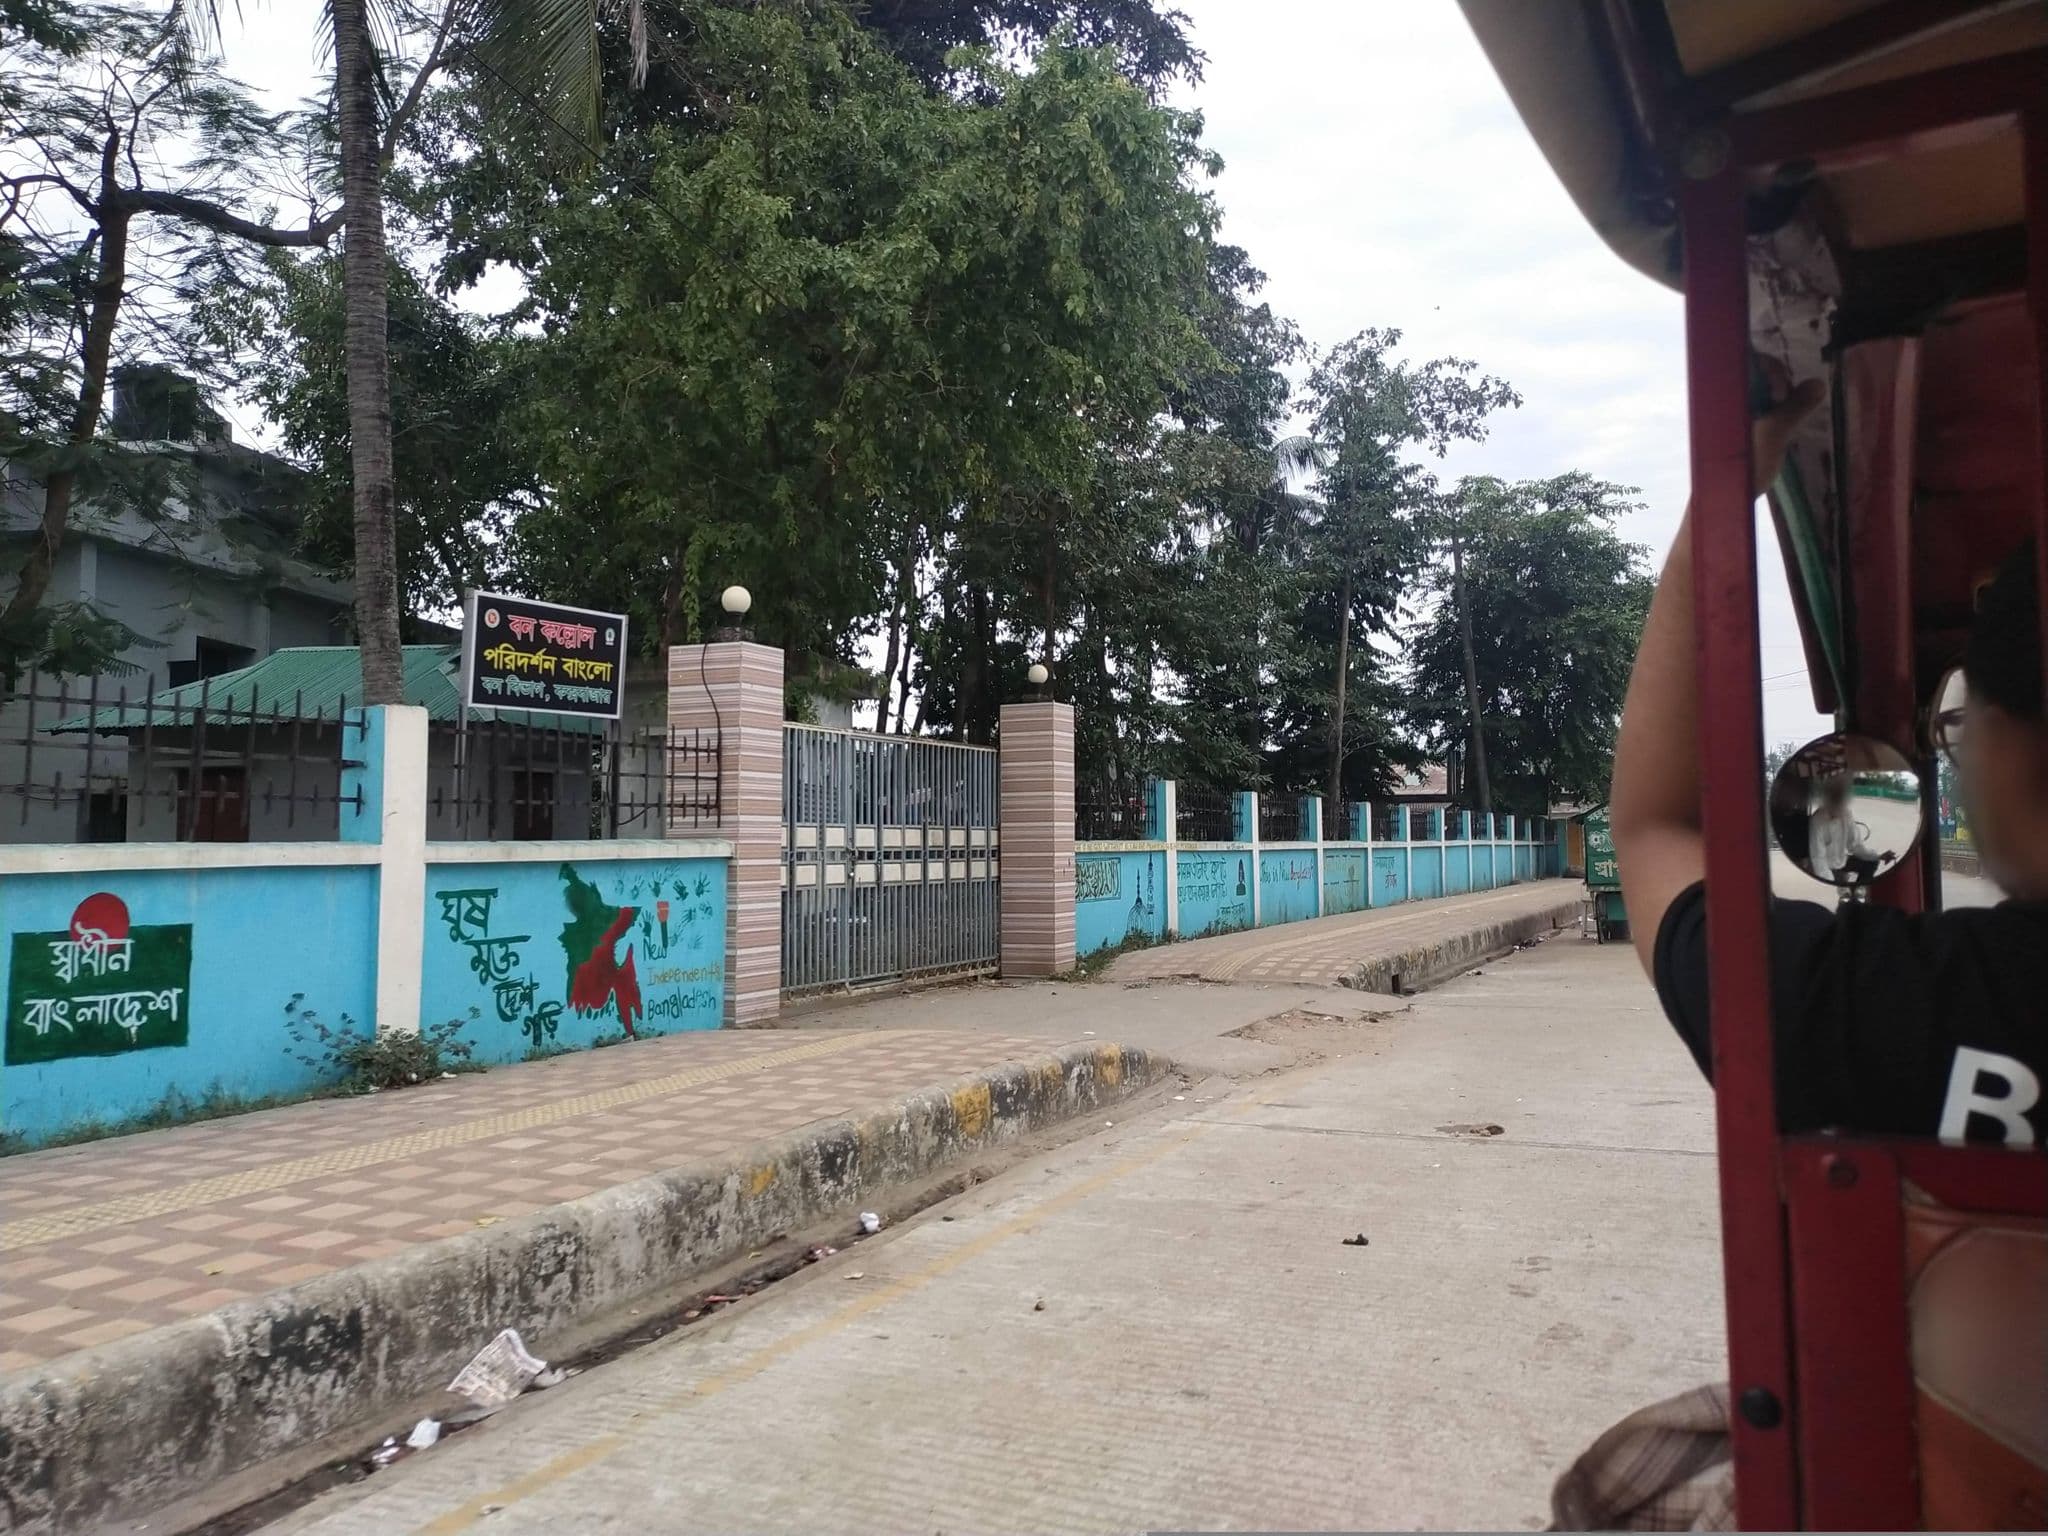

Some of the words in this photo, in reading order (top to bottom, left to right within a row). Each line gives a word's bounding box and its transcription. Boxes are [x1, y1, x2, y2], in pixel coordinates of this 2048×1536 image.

[507, 614, 537, 642] বন
[540, 618, 597, 650] কল্লোল
[484, 643, 558, 677] পরিদর্শন
[561, 657, 614, 682] বাংলো
[481, 676, 504, 695] বন
[553, 684, 613, 705] কক্সবাজার
[435, 888, 498, 942] ঘুষ
[48, 921, 135, 984] স্বাধীন
[462, 935, 532, 985] মুক্ত
[643, 937, 668, 961] New
[493, 971, 539, 1022] দেশ
[647, 986, 716, 1020] Bangladesh
